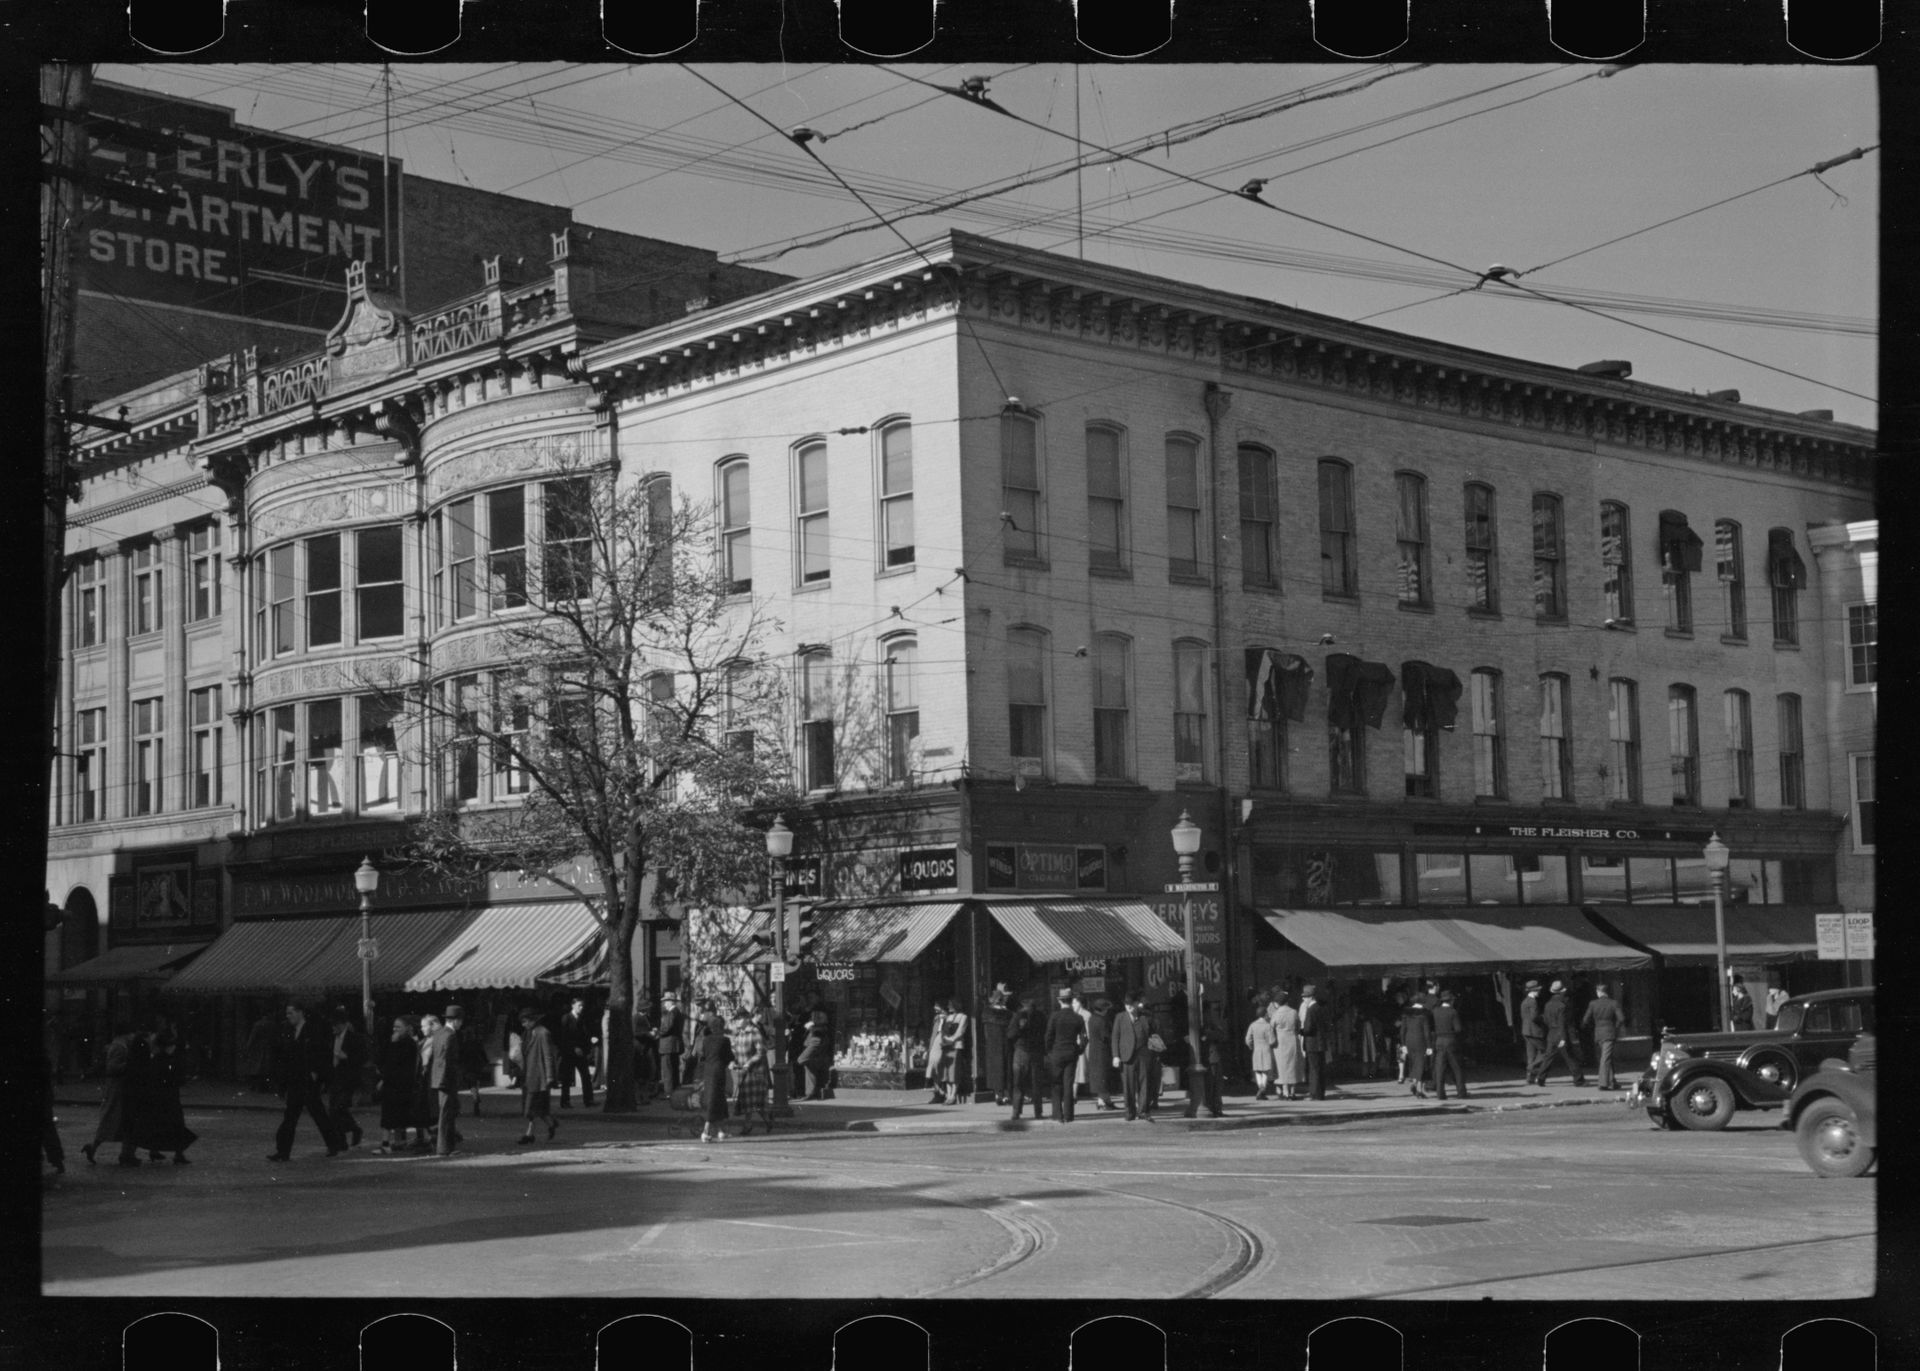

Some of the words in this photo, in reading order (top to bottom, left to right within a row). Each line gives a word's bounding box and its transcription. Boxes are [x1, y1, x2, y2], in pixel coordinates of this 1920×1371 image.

[89, 113, 370, 210] ERLY'S
[83, 180, 381, 263] ARTMENT
[89, 229, 239, 285] STORE.
[1509, 827, 1537, 837] THE
[1541, 828, 1610, 838] FLEISHER
[1616, 830, 1640, 839] CO.
[903, 859, 955, 880] LIQUORS
[1019, 851, 1074, 873] OPTIMO
[785, 868, 816, 886] INES
[280, 880, 379, 905] WOOLWOR
[1148, 899, 1219, 921] ERNY'S
[816, 968, 855, 981] LIQUORS
[1065, 958, 1107, 972] LIQUORS
[1147, 952, 1221, 988] GUNTER'S
